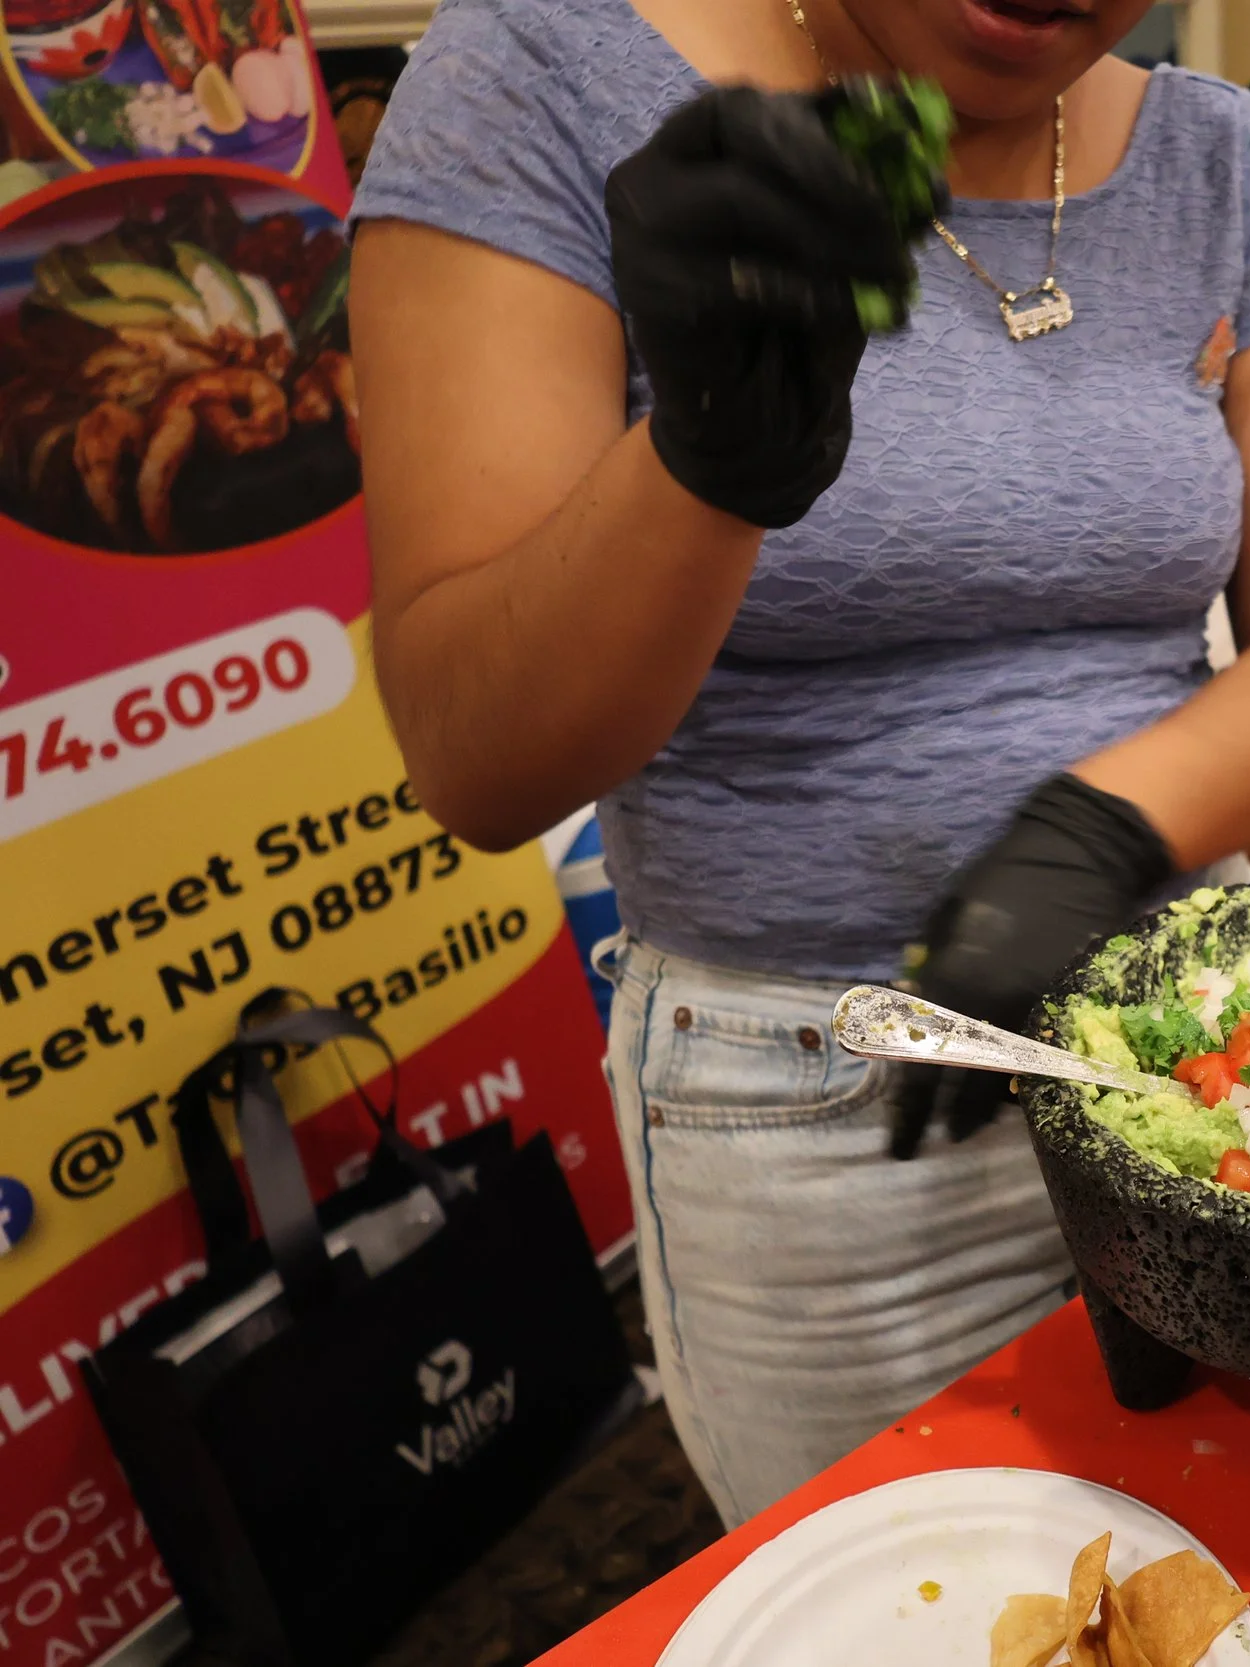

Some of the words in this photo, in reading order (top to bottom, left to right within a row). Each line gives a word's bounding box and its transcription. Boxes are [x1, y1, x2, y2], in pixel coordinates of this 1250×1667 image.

[157, 930, 252, 1014] NJ
[269, 833, 462, 953] 08873
[460, 1057, 525, 1127] IN
[392, 1364, 517, 1477] Valley
